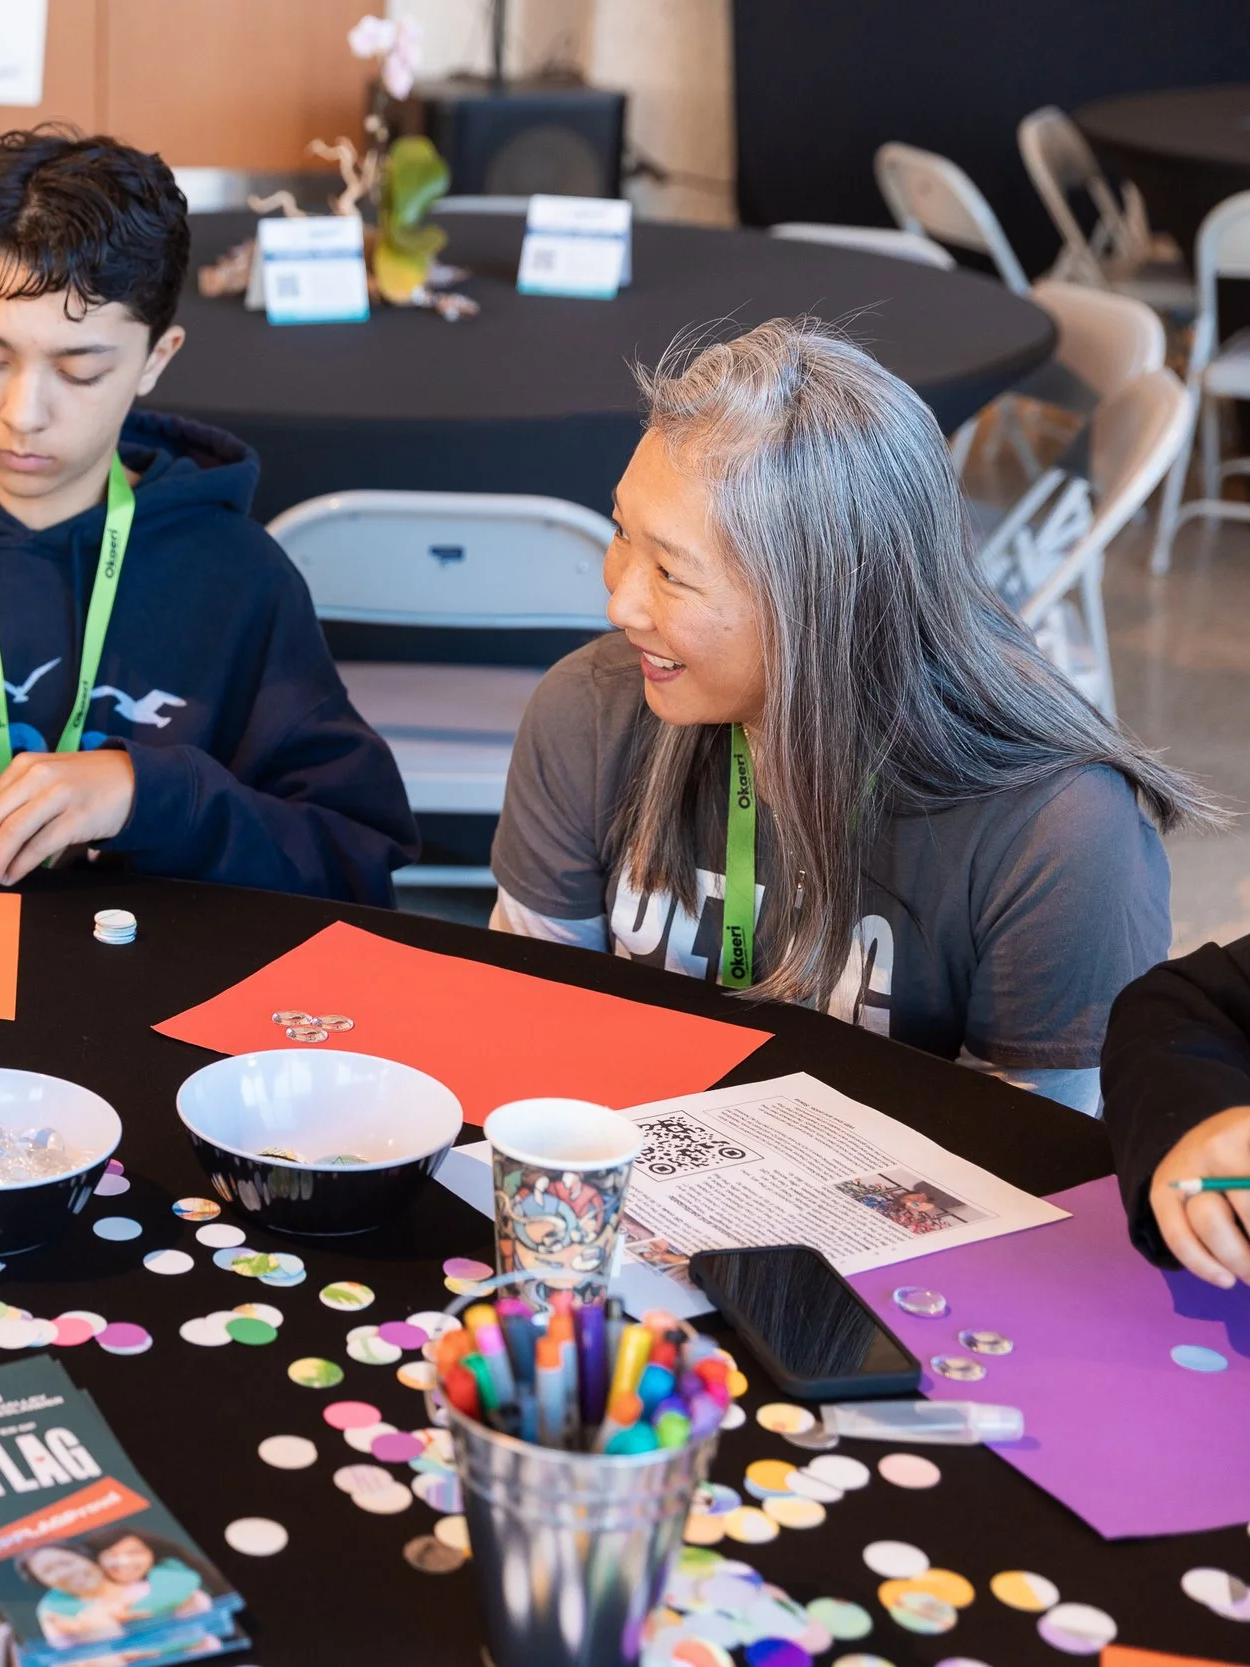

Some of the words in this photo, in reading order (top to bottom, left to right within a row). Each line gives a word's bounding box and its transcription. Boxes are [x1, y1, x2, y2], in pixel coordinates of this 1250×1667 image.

[105, 529, 118, 579] Okaeri
[73, 681, 88, 729] Okaeri
[734, 753, 751, 810] Okaeri
[726, 925, 746, 980] Okaeri
